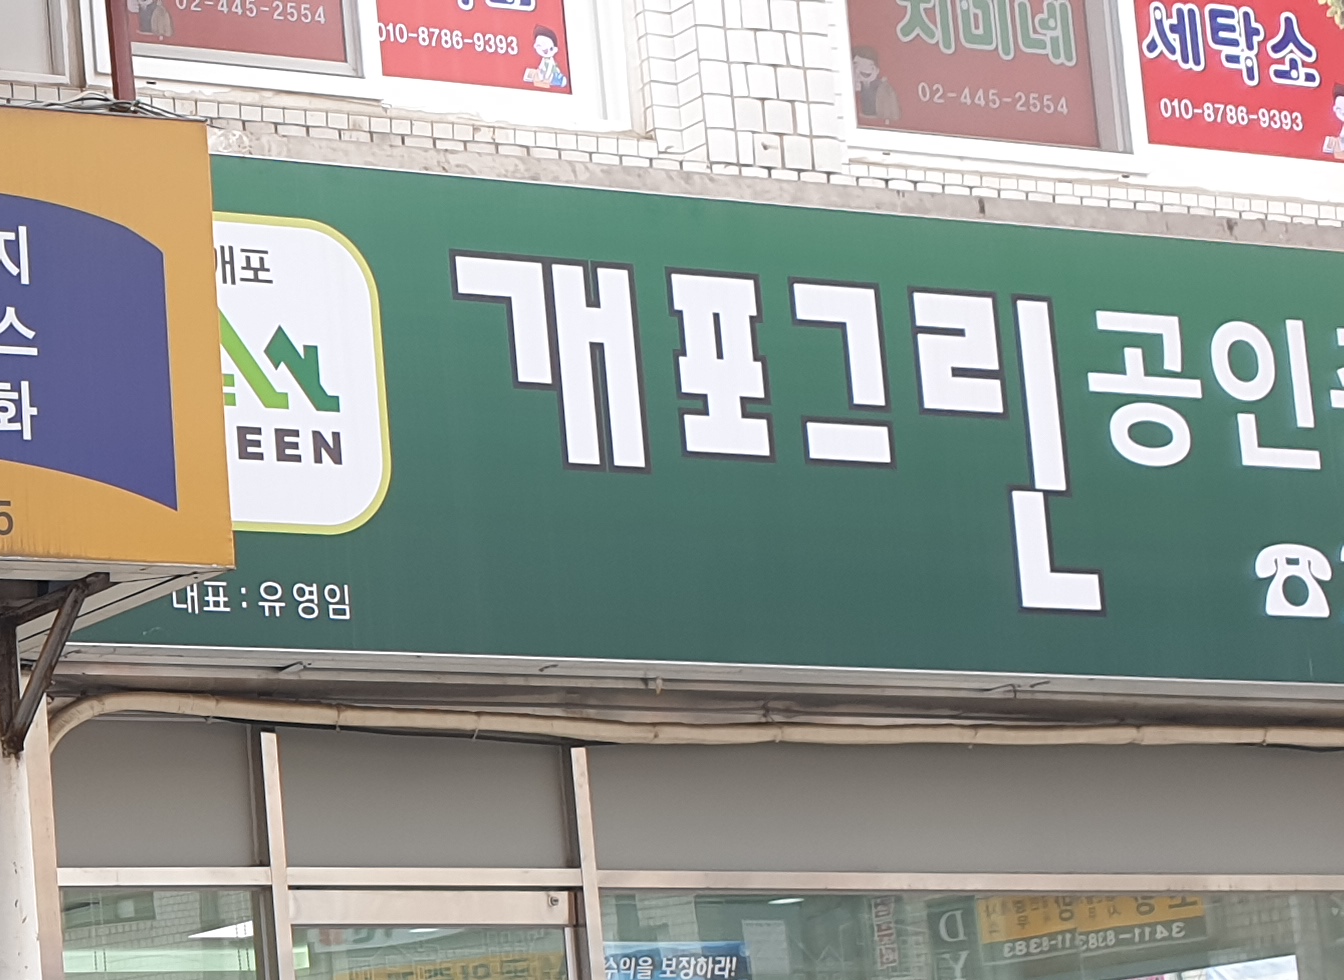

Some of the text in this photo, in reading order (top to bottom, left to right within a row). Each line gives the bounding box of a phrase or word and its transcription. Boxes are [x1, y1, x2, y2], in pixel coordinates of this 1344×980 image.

[1143, 1, 1321, 87] 세탁소
[917, 82, 1069, 115] 02-445-2554
[1160, 97, 1303, 131] 010-8786-9393
[1087, 310, 1344, 470] 공인
[236, 425, 343, 466] EEN
[257, 580, 351, 621] 유영임
[659, 956, 737, 980] 보장하라!
